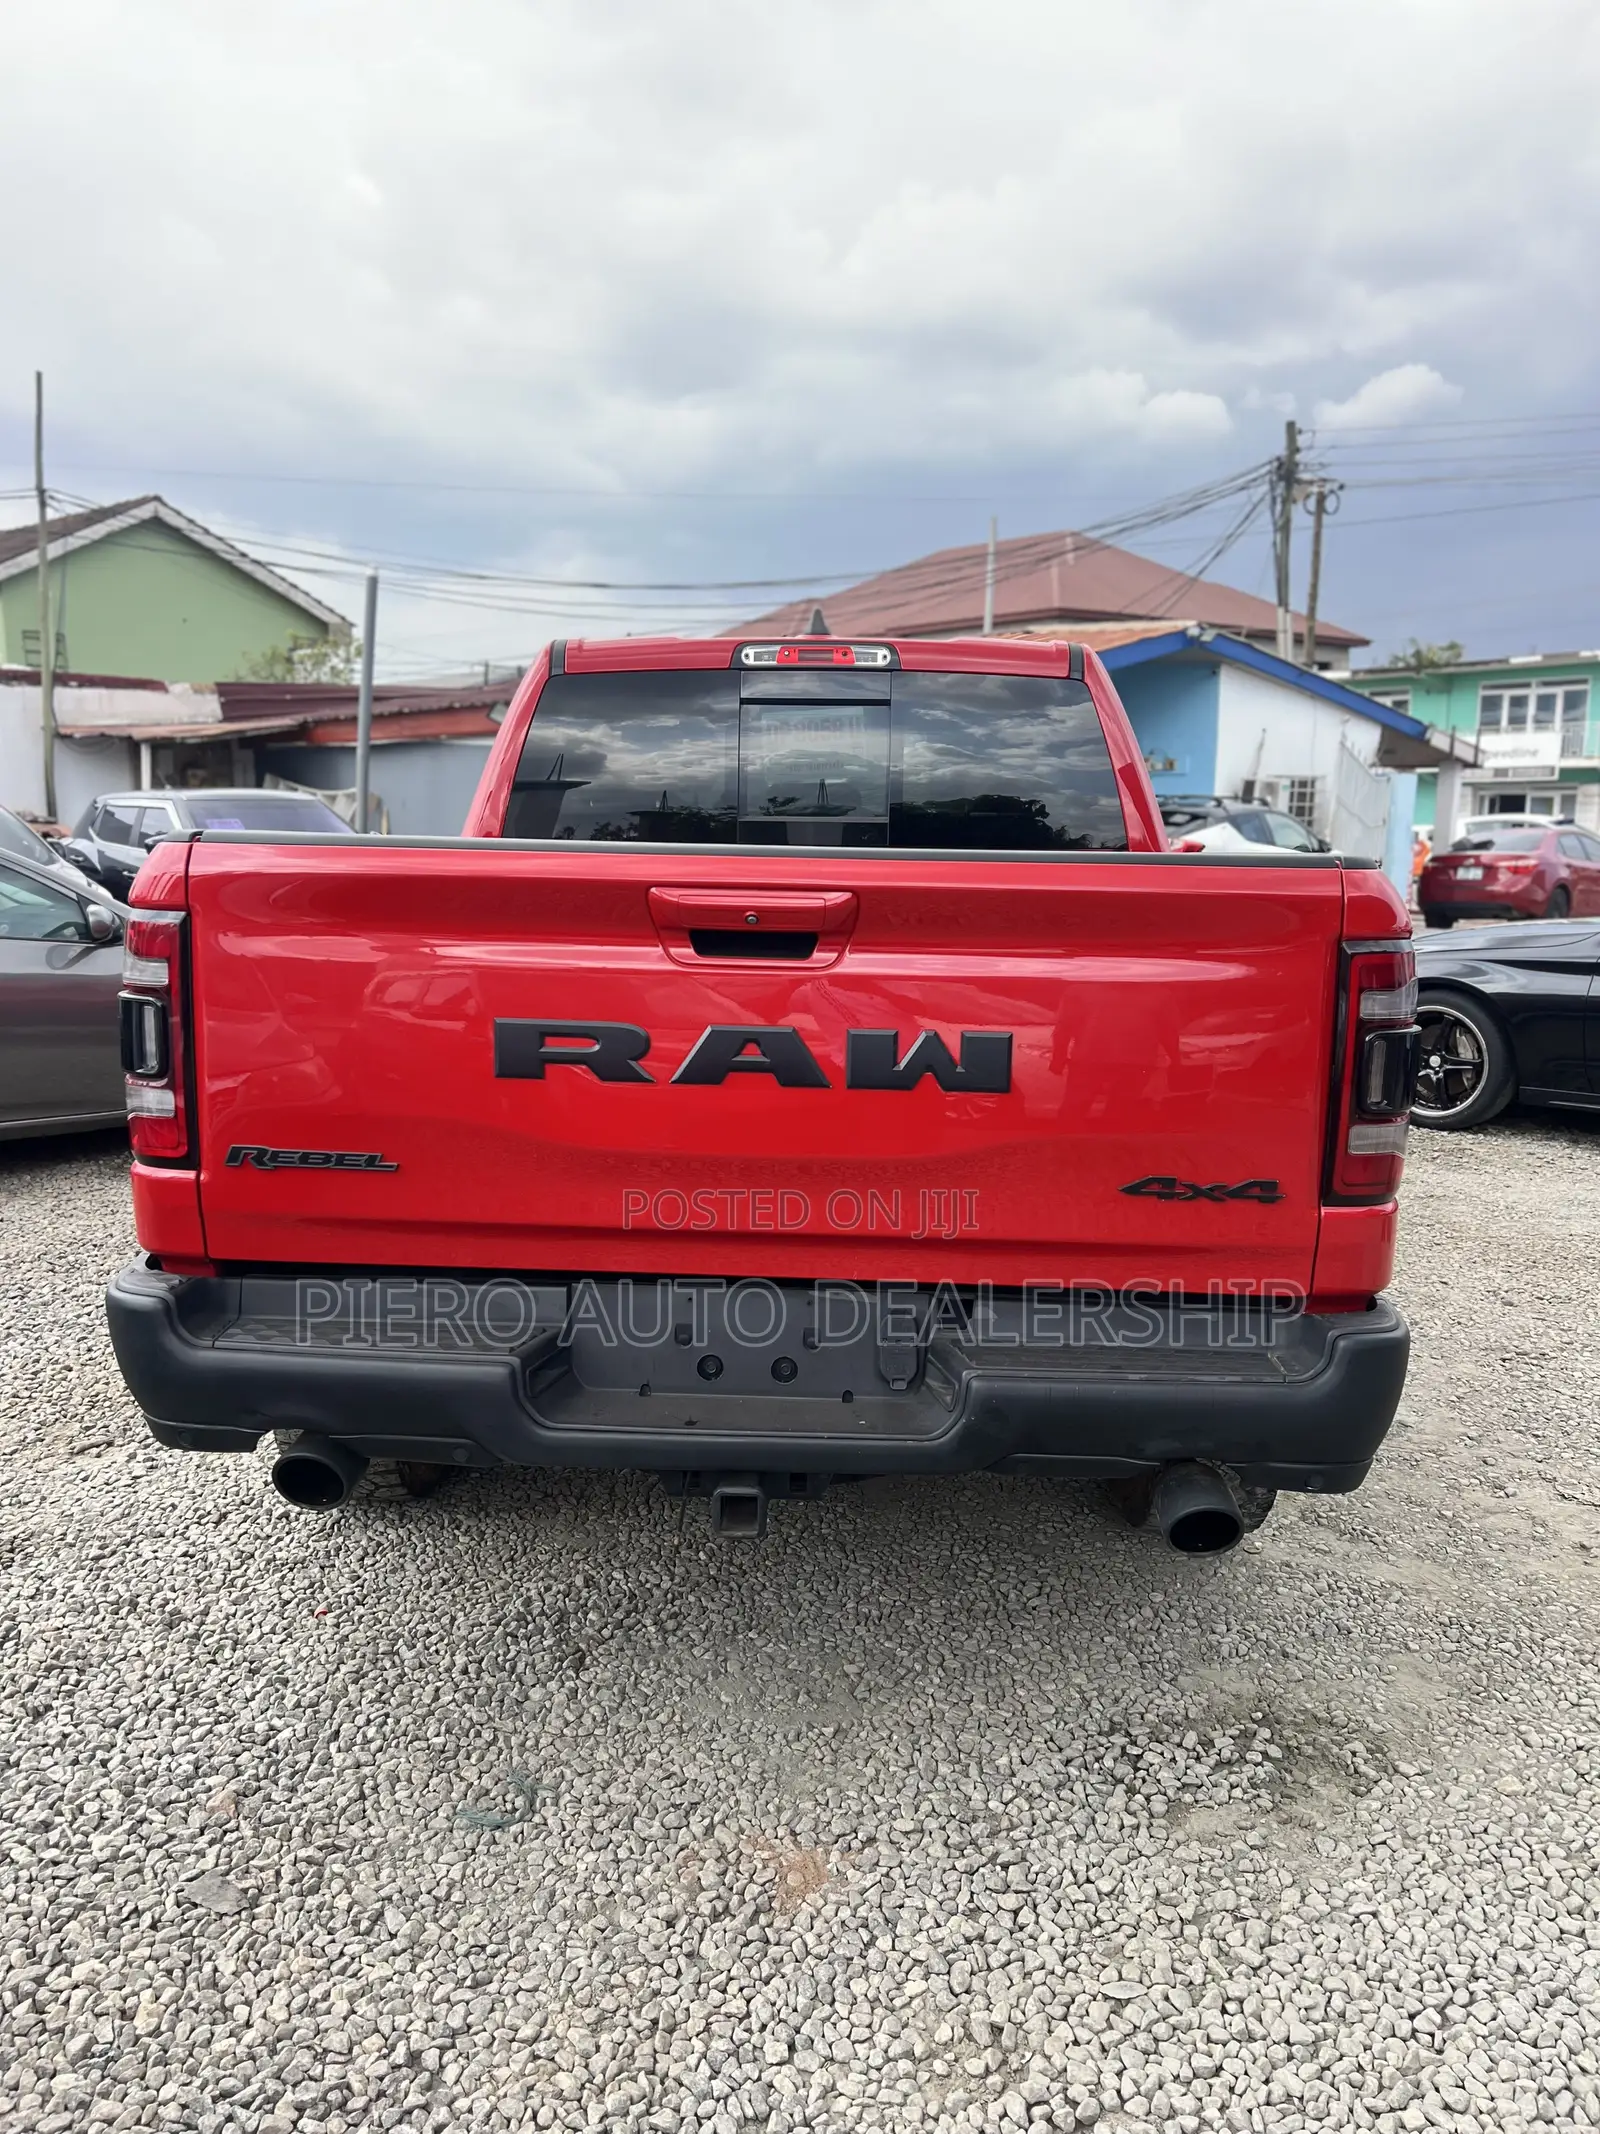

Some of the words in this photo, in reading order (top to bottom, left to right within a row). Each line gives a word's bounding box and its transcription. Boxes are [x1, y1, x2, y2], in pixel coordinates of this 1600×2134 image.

[494, 1017, 1013, 1093] RAW
[224, 1144, 400, 1171] REBEL
[1116, 1175, 1287, 1204] 4x4
